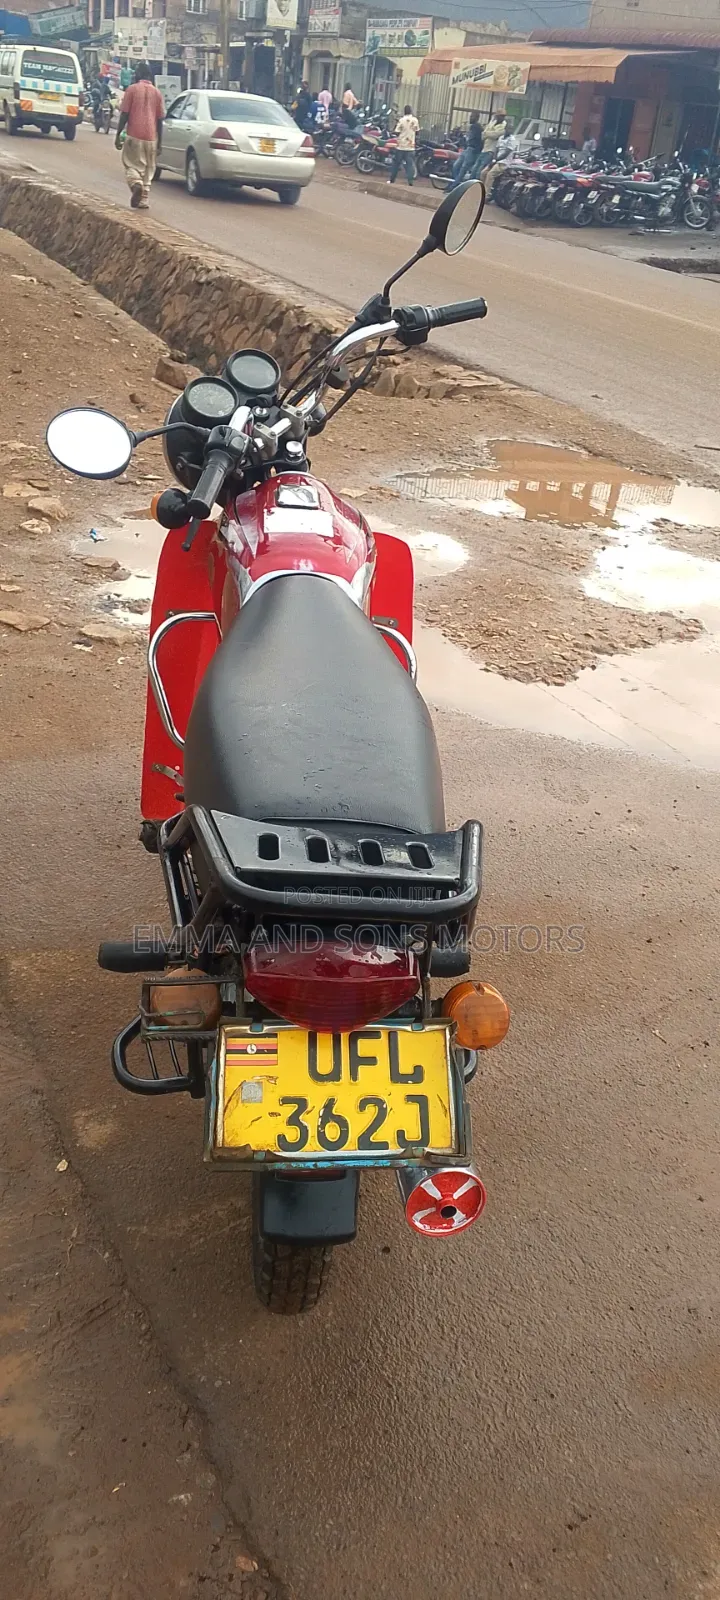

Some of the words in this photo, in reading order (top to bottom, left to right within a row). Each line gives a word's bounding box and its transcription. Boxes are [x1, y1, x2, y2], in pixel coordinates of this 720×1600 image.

[23, 62, 41, 70] TEAM
[451, 63, 487, 85] MUNUBBI
[307, 1030, 425, 1084] UFL
[276, 1094, 431, 1152] 362J
